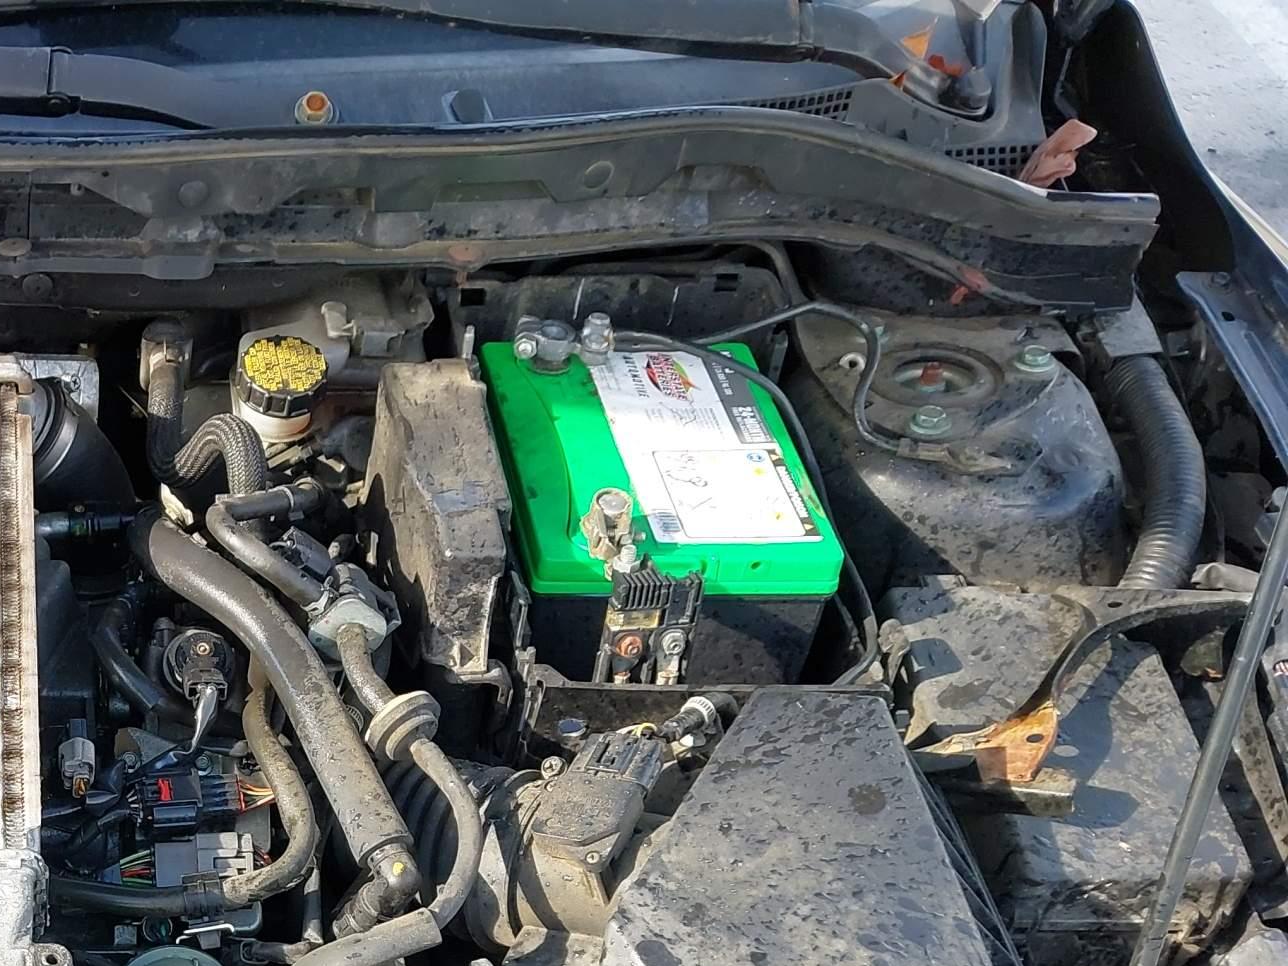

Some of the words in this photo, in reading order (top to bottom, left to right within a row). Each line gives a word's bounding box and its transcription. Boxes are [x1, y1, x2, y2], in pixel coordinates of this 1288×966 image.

[622, 355, 650, 398] AUTOMOTIVE
[648, 354, 672, 396] BATTERIES
[658, 353, 689, 401] INTERSTATE
